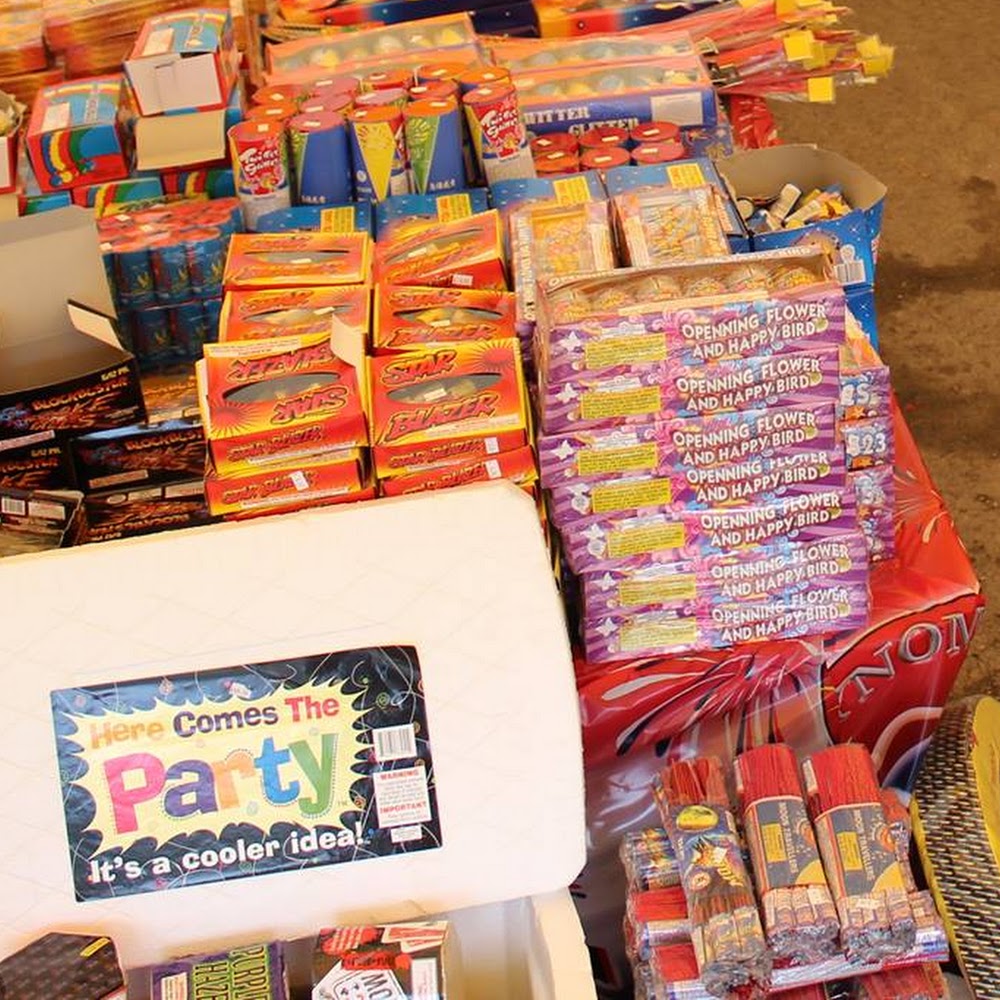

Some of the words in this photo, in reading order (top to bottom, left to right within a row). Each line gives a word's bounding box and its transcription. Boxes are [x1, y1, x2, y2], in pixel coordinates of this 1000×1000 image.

[681, 313, 759, 341] OPENNING
[767, 302, 827, 323] FLOWER
[693, 342, 724, 359] AND
[728, 327, 777, 353] HAPPY
[782, 318, 816, 339] BIRD
[382, 350, 457, 386] STAR
[676, 369, 754, 395] OPENNING
[761, 357, 820, 379] FLOWER
[686, 396, 718, 412] AND
[723, 382, 772, 406] HAPPY
[776, 374, 810, 393] BIRD
[384, 391, 500, 441] BLAZER
[673, 423, 750, 448] OPENNING
[757, 412, 816, 432] FLOWER
[683, 449, 715, 466] AND
[719, 436, 768, 461] HAPPY
[772, 429, 806, 447] BIRD
[686, 460, 763, 484] OPENNING
[697, 486, 728, 503] AND
[732, 473, 781, 497] HAPPY
[785, 466, 819, 484] BIRD
[701, 504, 776, 529] OPENNING
[783, 493, 840, 513] FLOWER
[710, 530, 742, 547] AND
[745, 517, 794, 542] HAPPY
[797, 509, 830, 528] BIRD
[711, 555, 785, 579] OPENNING
[792, 544, 849, 563] FLOWER
[721, 581, 752, 597] AND
[756, 569, 802, 593] HAPPY
[806, 560, 839, 577] BIRD
[712, 601, 785, 626] OPENNING
[792, 589, 849, 609] FLOWER
[721, 625, 752, 642] AND
[756, 613, 802, 637] HAPPY
[806, 606, 839, 623] BIRD
[89, 718, 165, 749] Here
[173, 706, 279, 738] Comes
[285, 695, 340, 723] The
[104, 733, 338, 834] Party
[380, 769, 419, 781] WARNING
[380, 801, 427, 814] IMPORTANT
[89, 859, 142, 885] It's
[152, 857, 171, 875] a
[182, 838, 281, 868] cooler
[290, 821, 363, 855] idea!
